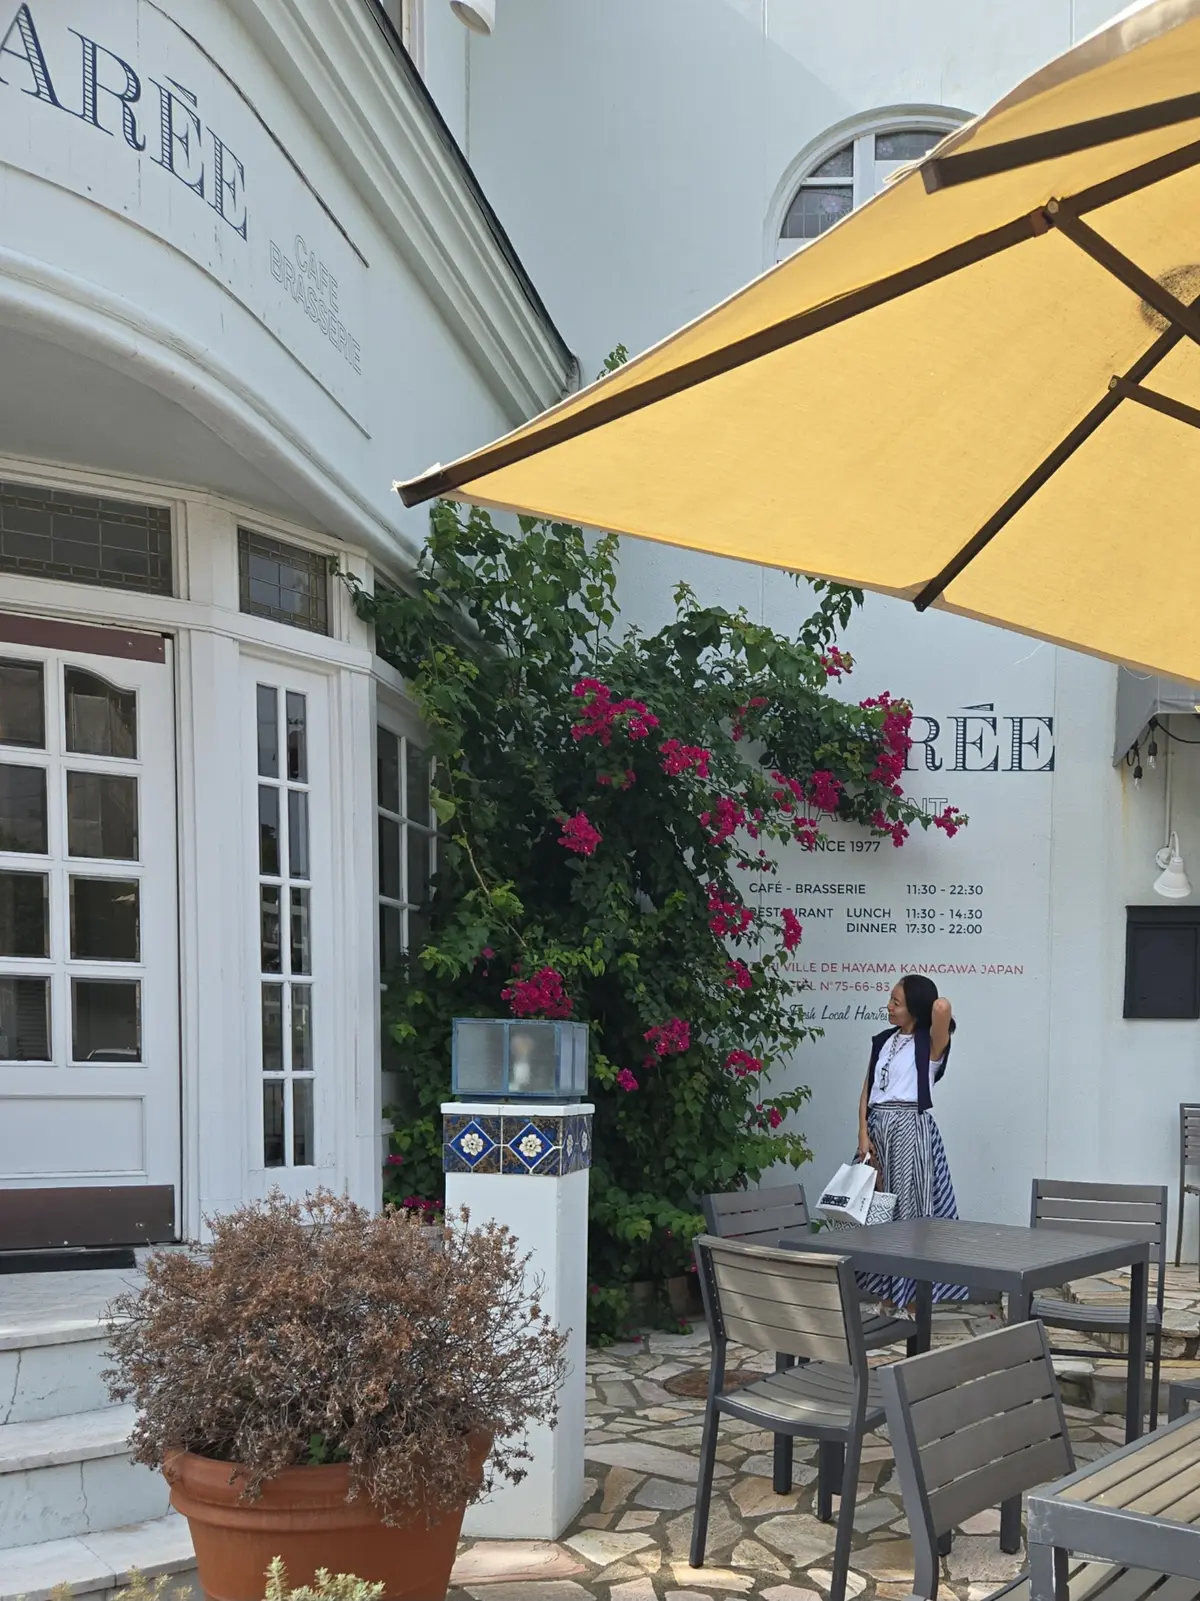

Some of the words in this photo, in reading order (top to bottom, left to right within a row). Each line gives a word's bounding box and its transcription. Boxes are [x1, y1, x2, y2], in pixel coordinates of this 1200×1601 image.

[294, 234, 339, 313] CAFE
[269, 239, 362, 376] BRASSERIE
[901, 702, 1056, 772] RÉE
[801, 840, 845, 852] SNCE
[850, 841, 880, 852] 1977
[749, 880, 782, 893] CAFÉ
[795, 884, 866, 894] BRASSERIE
[906, 885, 937, 895] 11:30
[949, 885, 984, 895] 22:30
[846, 908, 891, 918] LUNCH
[906, 909, 936, 919] 11:30
[949, 909, 983, 919] 14:30
[846, 923, 897, 933] DINNER
[905, 923, 936, 934] 17:30
[948, 924, 983, 934] 22:00
[784, 962, 817, 973] VILLE
[821, 963, 838, 973] DE
[842, 963, 896, 973] HAYAMA
[900, 963, 977, 974] KANAGAWA
[981, 964, 1024, 975] JAPAN
[821, 1004, 850, 1020] Local
[854, 1003, 888, 1021] Harves
